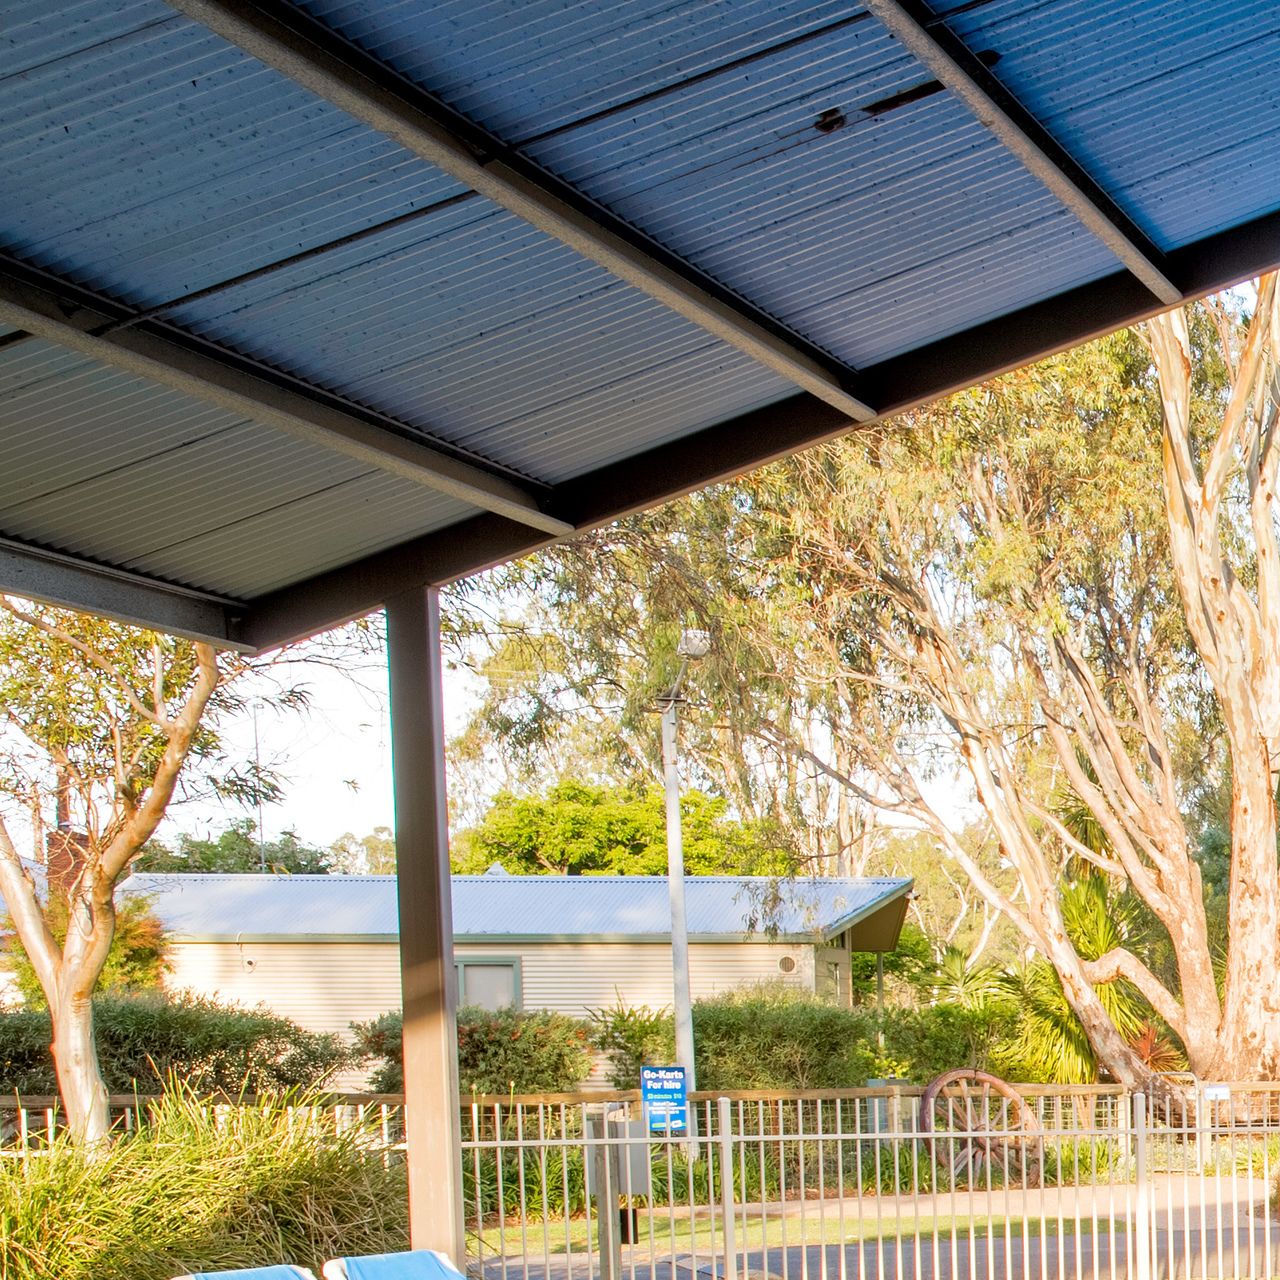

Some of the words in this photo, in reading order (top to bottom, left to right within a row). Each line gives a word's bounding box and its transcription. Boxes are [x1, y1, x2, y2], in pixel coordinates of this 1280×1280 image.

[643, 1070, 684, 1079] Go-Karts
[647, 1080, 662, 1089] For
[663, 1080, 681, 1089] hire
